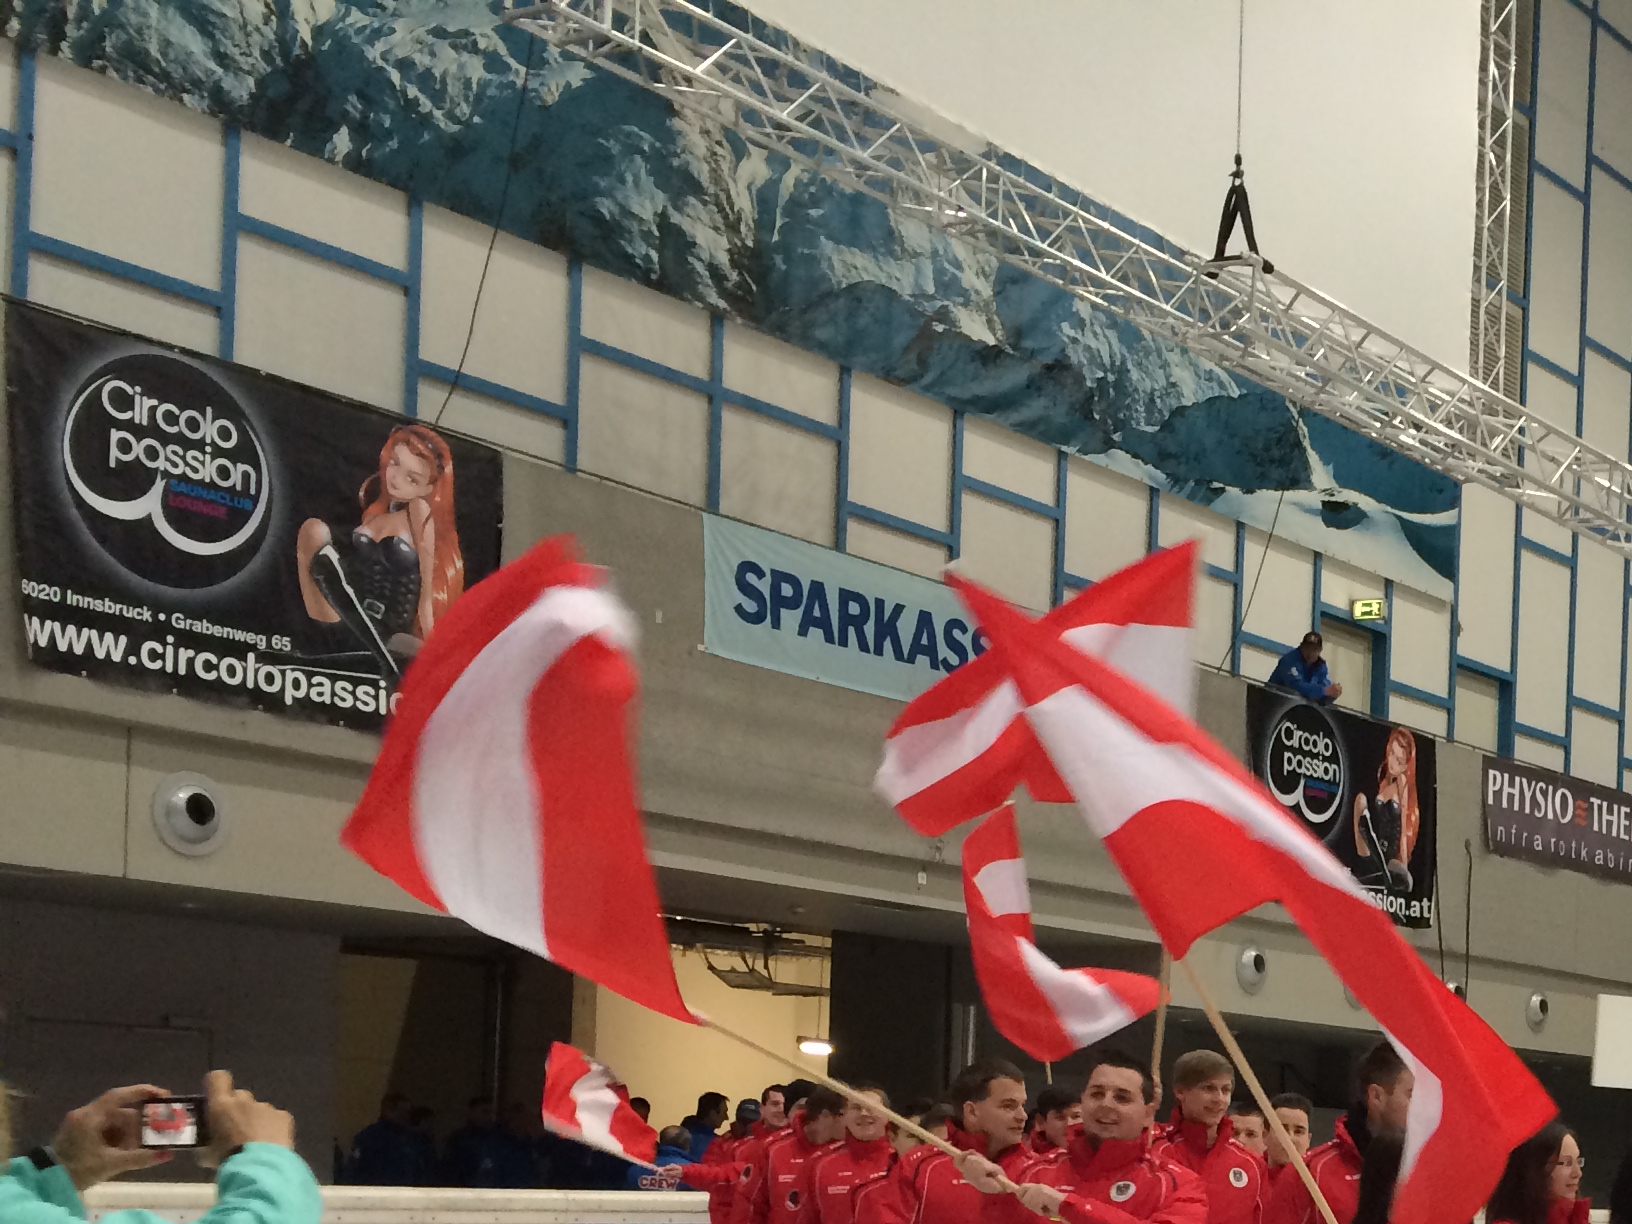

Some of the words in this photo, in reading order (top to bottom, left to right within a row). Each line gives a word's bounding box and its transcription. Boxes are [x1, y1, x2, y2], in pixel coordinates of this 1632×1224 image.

[101, 379, 238, 449] Circolo
[109, 427, 257, 496] passion
[21, 578, 61, 603] 6020
[66, 589, 153, 623] Innsbruck
[171, 612, 267, 650] Grabenweg
[271, 633, 292, 652] 65
[1280, 721, 1333, 757] Circolo
[1283, 751, 1340, 784] passion
